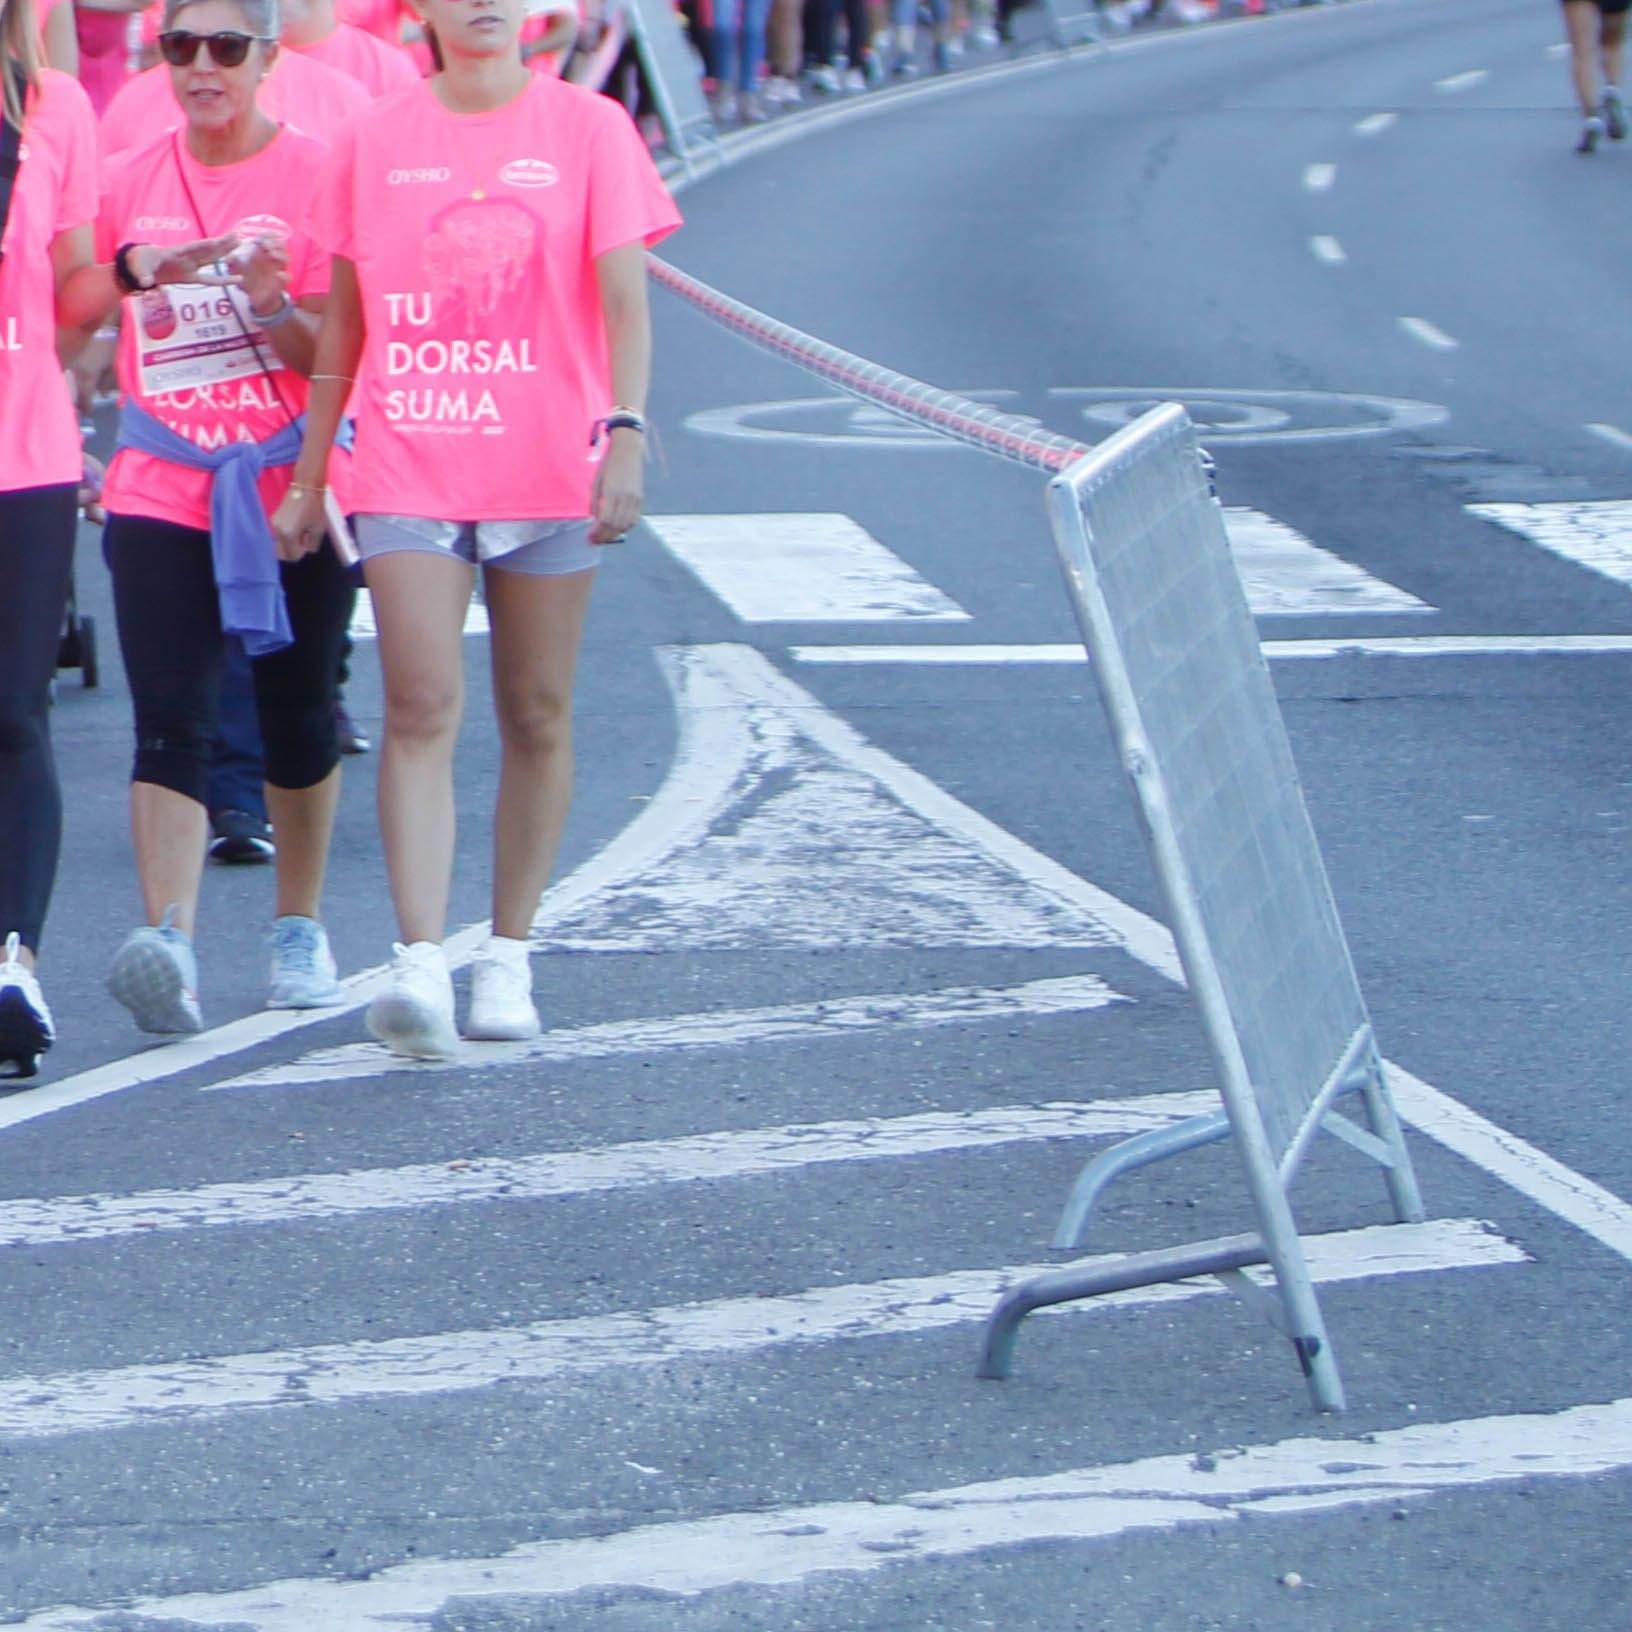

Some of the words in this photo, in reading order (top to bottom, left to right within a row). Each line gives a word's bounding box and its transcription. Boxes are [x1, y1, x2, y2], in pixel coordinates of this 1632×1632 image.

[388, 168, 451, 185] OYSHO
[180, 297, 235, 322] 016
[384, 292, 432, 326] TU
[387, 338, 537, 376] DORSAL
[385, 389, 502, 421] SUMA
